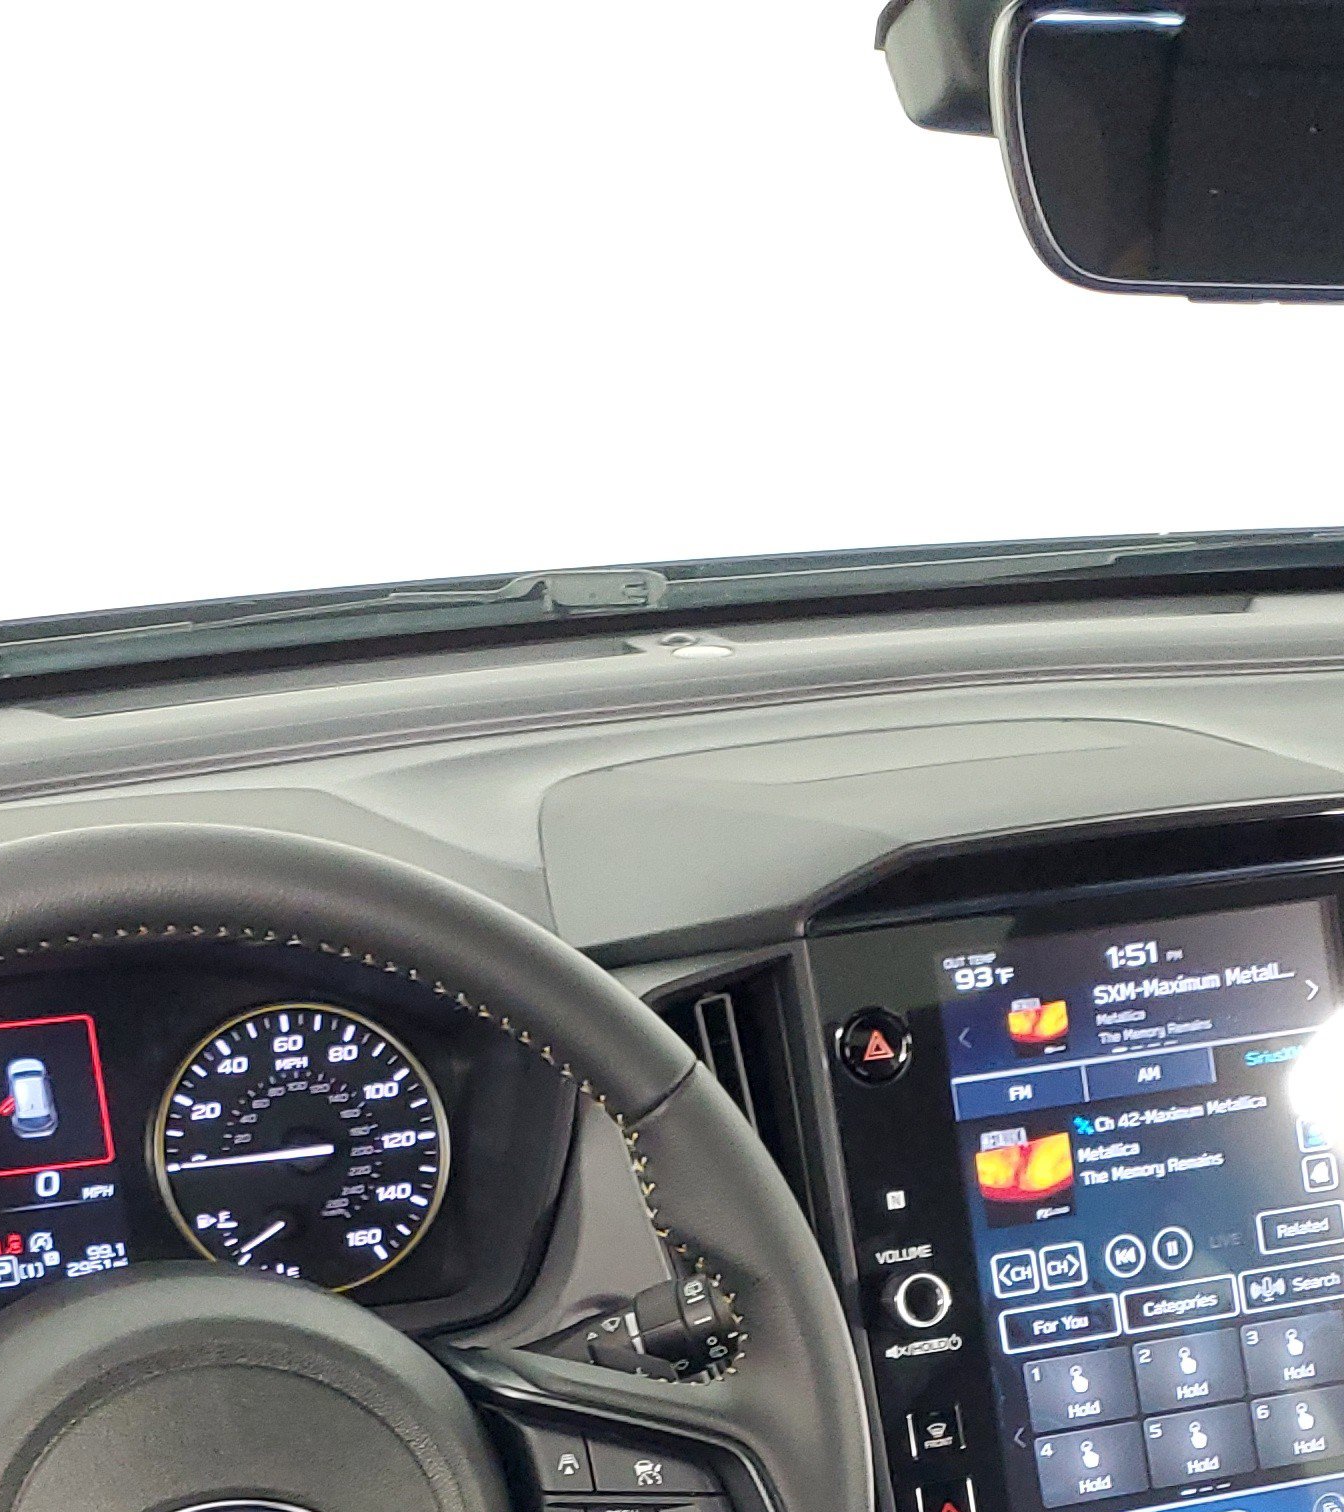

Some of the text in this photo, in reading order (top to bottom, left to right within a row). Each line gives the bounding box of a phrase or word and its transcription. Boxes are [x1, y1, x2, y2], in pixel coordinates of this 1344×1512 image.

[1105, 941, 1158, 969] 1:51
[1093, 974, 1221, 1005] SXM-Maximum
[273, 1034, 304, 1053] 60
[327, 1045, 358, 1062] 80
[217, 1057, 249, 1074] 40
[275, 1056, 309, 1071] MPH
[363, 1082, 399, 1100] 100
[1009, 1065, 1162, 1101] FM AM
[191, 1102, 221, 1120] 20
[1094, 1116, 1115, 1132] Ch
[1206, 1095, 1267, 1116] Metallica
[381, 1131, 417, 1149] 120
[1077, 1142, 1141, 1163] Metallica
[1079, 1152, 1225, 1186] The Memory Remains
[82, 1184, 114, 1199] MPH
[375, 1182, 412, 1201] 140
[346, 1228, 382, 1247] 160
[1276, 1217, 1330, 1239] Related
[875, 1244, 934, 1265] VOLUME
[1291, 1271, 1341, 1292] Search
[1143, 1293, 1219, 1317] Categories
[1032, 1315, 1089, 1336] For You
[1245, 1330, 1260, 1345] 3
[1138, 1349, 1153, 1364] 2
[1031, 1366, 1041, 1382] 1
[1283, 1363, 1316, 1381] Hold
[1176, 1381, 1209, 1400] Hold
[1067, 1400, 1102, 1419] Hold
[1256, 1404, 1271, 1419] 6
[1148, 1423, 1163, 1439] 5
[1040, 1442, 1054, 1459] 4
[1293, 1436, 1326, 1455] Hold
[1186, 1456, 1220, 1475] Hold
[1079, 1475, 1113, 1495] Hold
